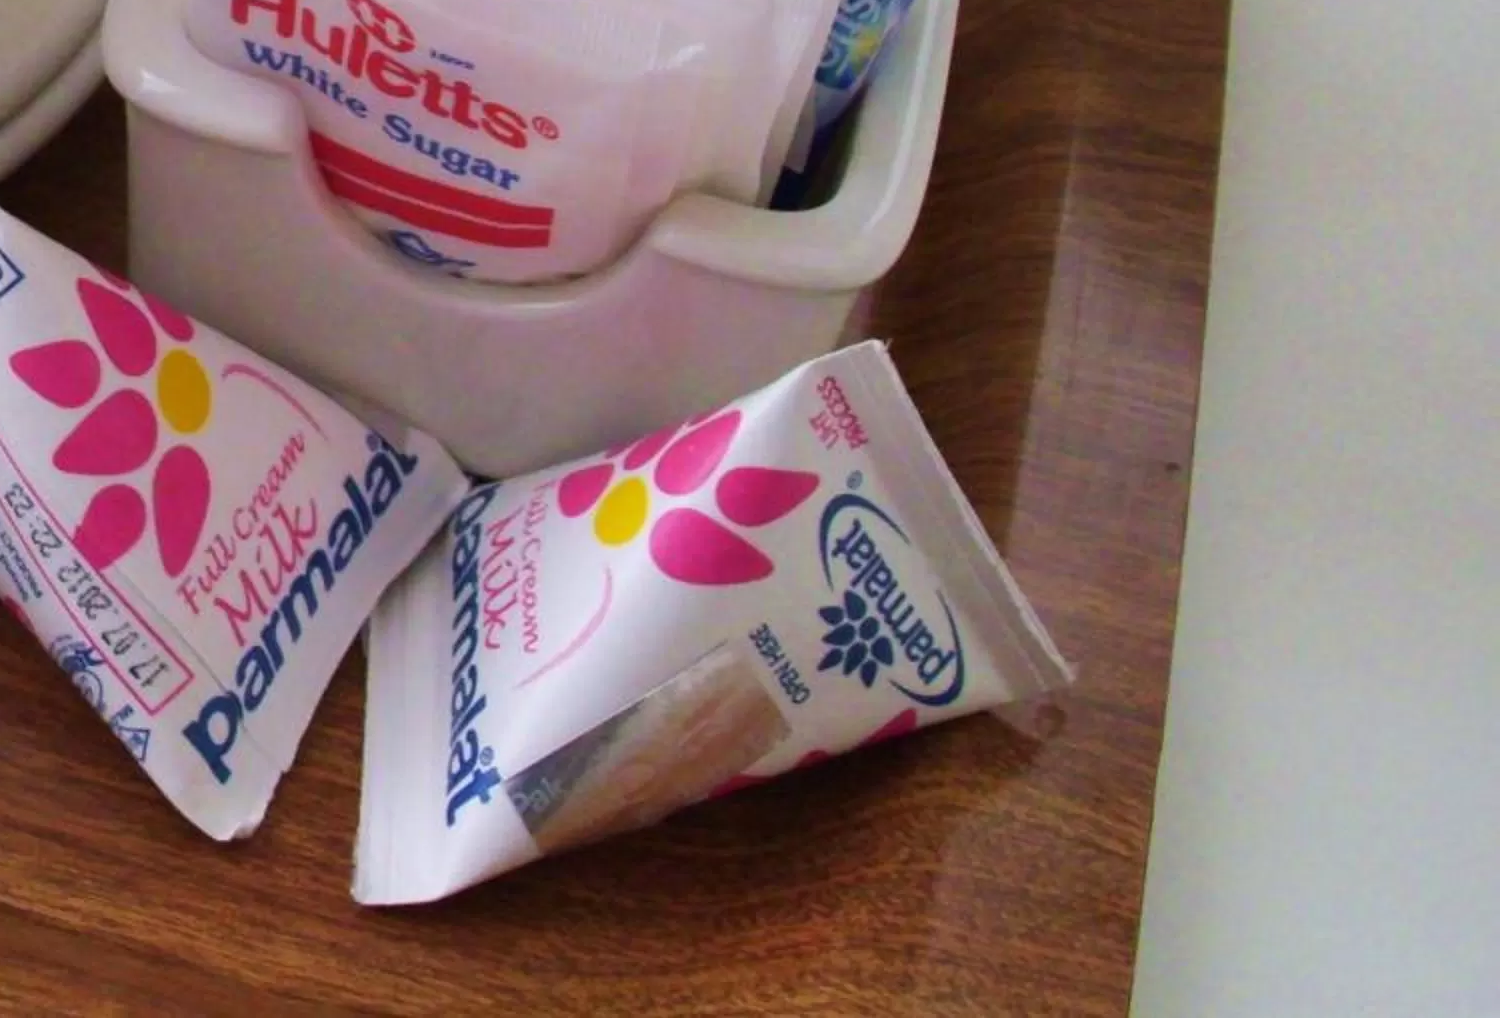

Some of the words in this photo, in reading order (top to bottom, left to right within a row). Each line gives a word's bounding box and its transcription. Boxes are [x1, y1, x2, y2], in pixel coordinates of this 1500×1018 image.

[241, 37, 369, 119] White
[381, 112, 521, 191] Sugar
[176, 534, 236, 615] Full
[232, 431, 306, 541] Cream
[213, 498, 319, 647] Milk
[481, 505, 526, 650] Milk
[520, 537, 542, 654] Cream
[747, 623, 787, 667] HERE
[830, 518, 955, 685] parmalat
[773, 659, 812, 705] OPEN
